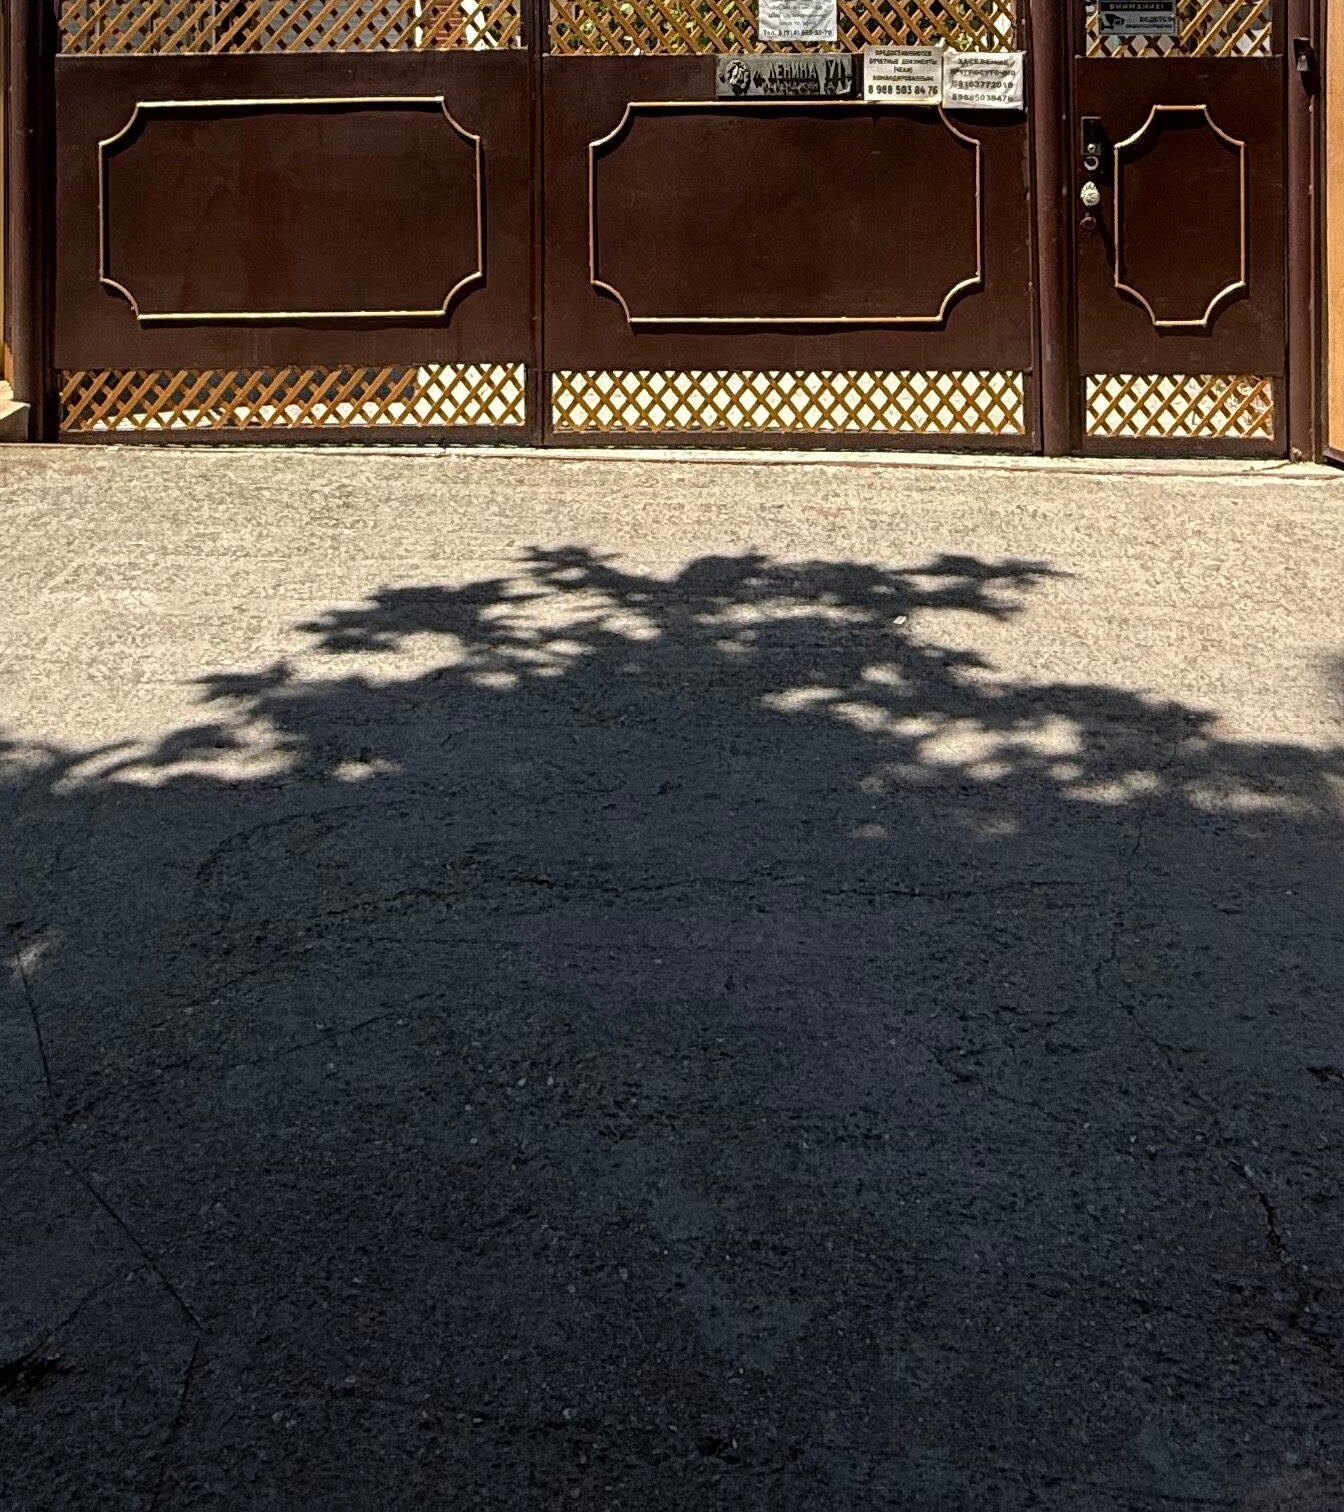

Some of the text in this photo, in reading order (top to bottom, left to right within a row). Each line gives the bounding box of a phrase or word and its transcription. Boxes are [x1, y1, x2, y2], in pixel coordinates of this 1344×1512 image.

[768, 60, 817, 79] ЛЕНИНА
[868, 85, 874, 94] 8
[896, 85, 912, 95] 503
[928, 86, 939, 95] 76
